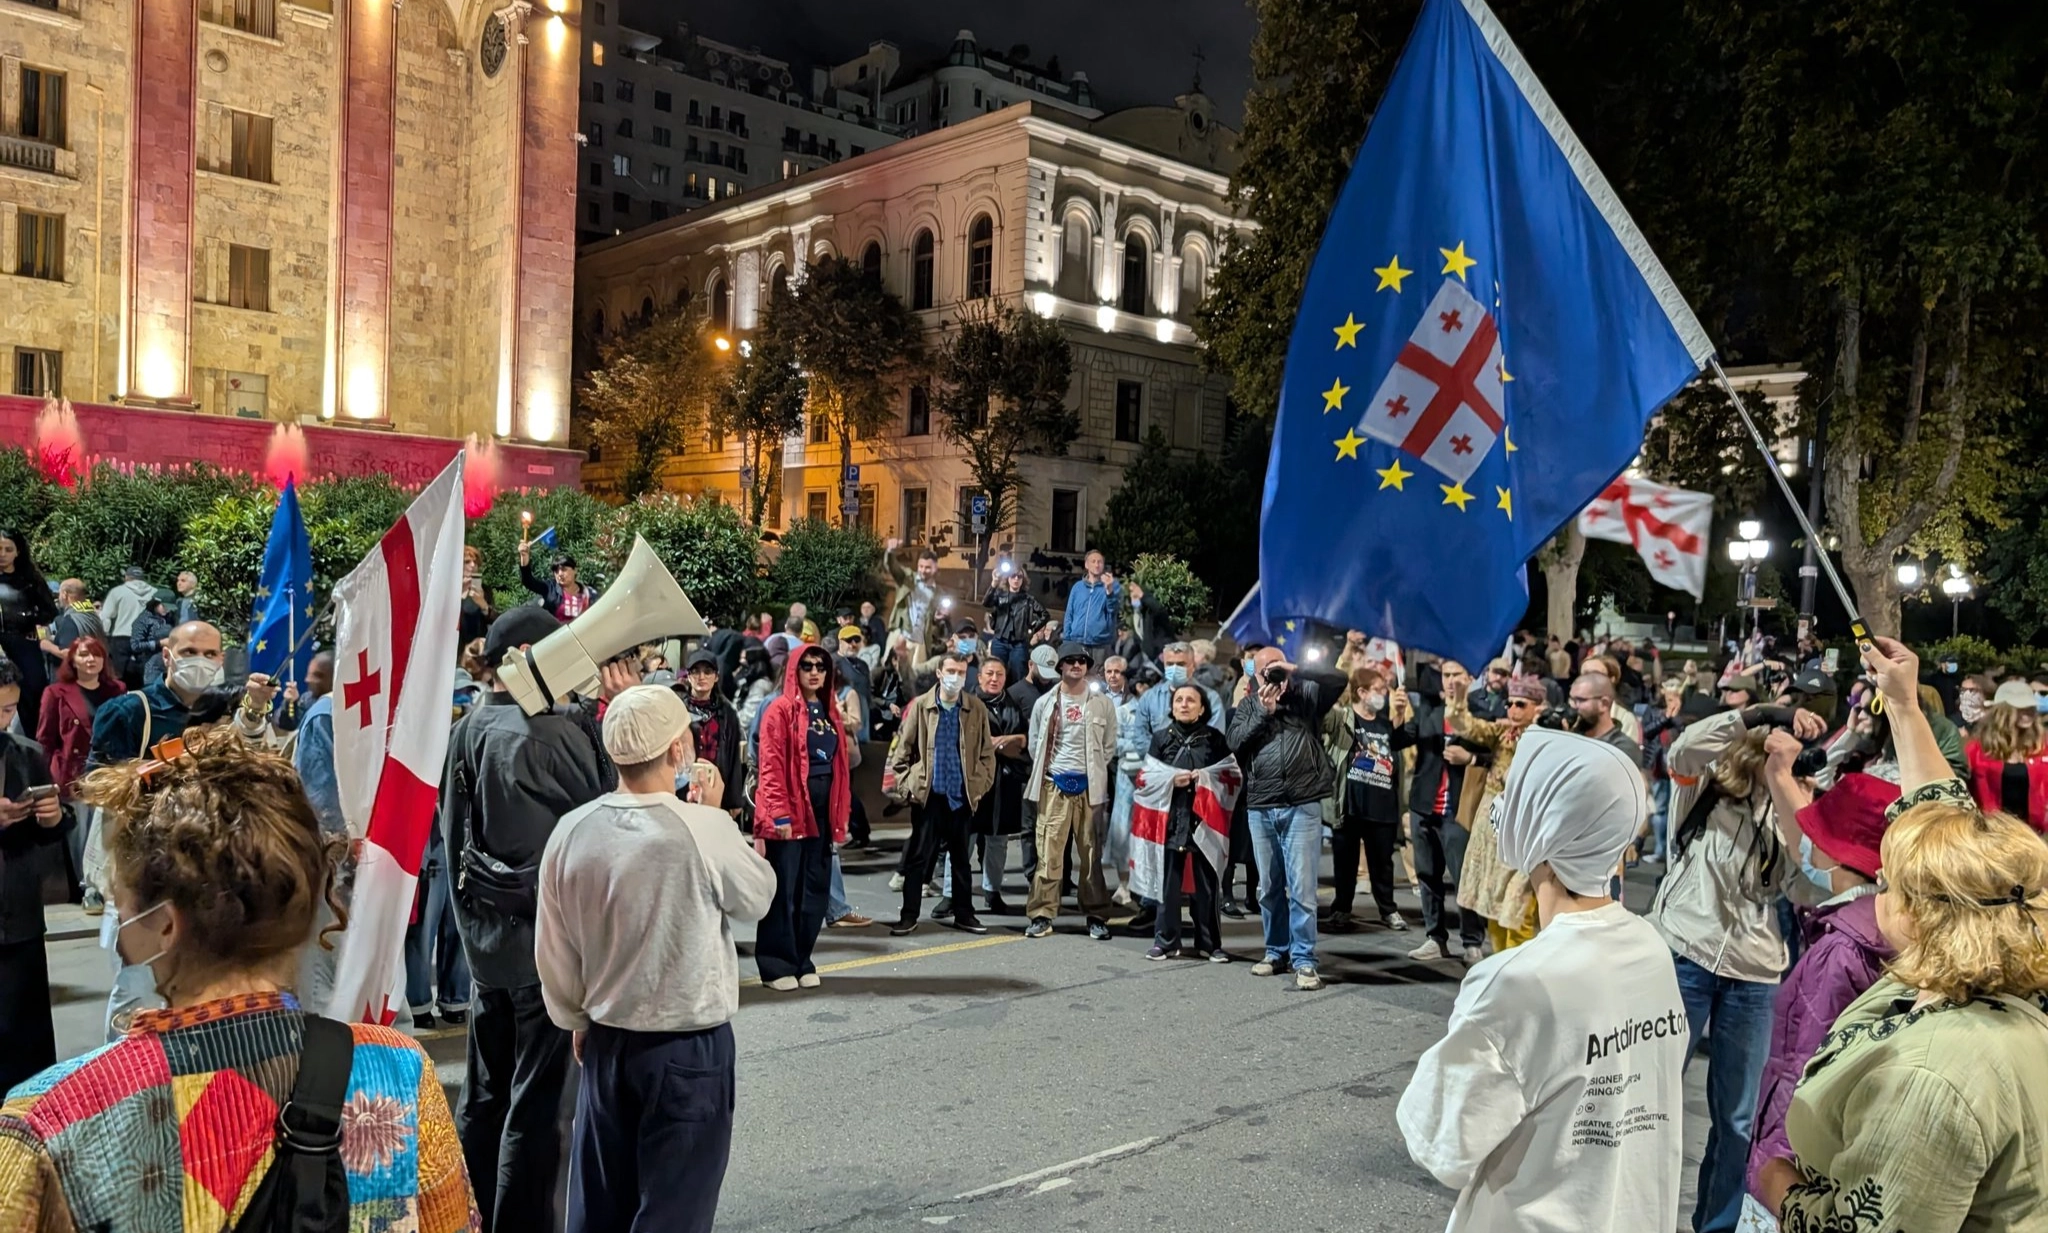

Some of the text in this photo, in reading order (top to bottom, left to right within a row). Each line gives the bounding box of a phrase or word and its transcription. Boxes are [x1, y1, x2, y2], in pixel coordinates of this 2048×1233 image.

[849, 466, 858, 480] P
[1587, 1073, 1623, 1086] SIGNER
[1572, 1128, 1613, 1139] ORIGINAL,
[1634, 1113, 1669, 1123] SENSITIVE,
[1574, 1120, 1614, 1129] CREATIVE,
[1572, 1137, 1621, 1147] INDEPENDE
